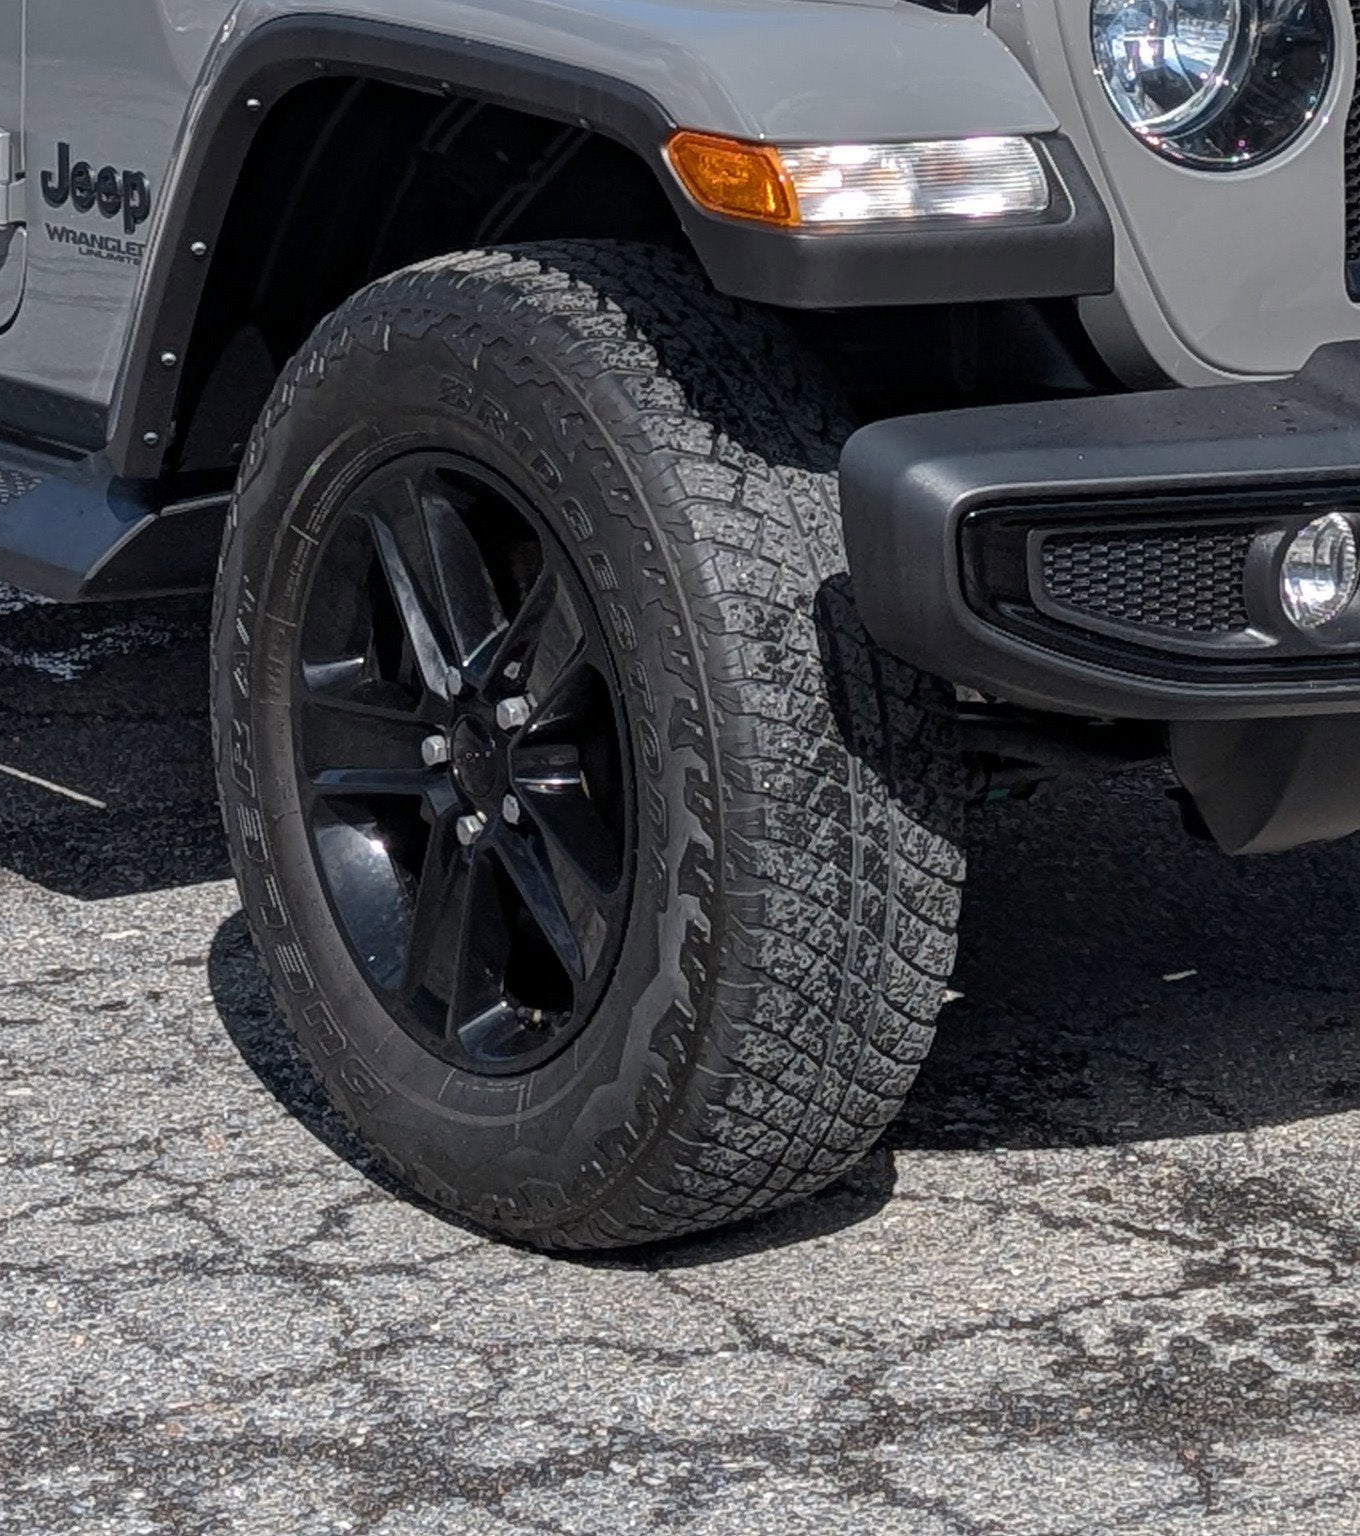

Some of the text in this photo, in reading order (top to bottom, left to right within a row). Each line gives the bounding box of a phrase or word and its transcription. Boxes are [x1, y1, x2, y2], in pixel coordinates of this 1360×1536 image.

[40, 141, 151, 235] Jeep
[78, 246, 141, 266] UNLIMITE
[437, 372, 671, 914] BRIDGESTONE
